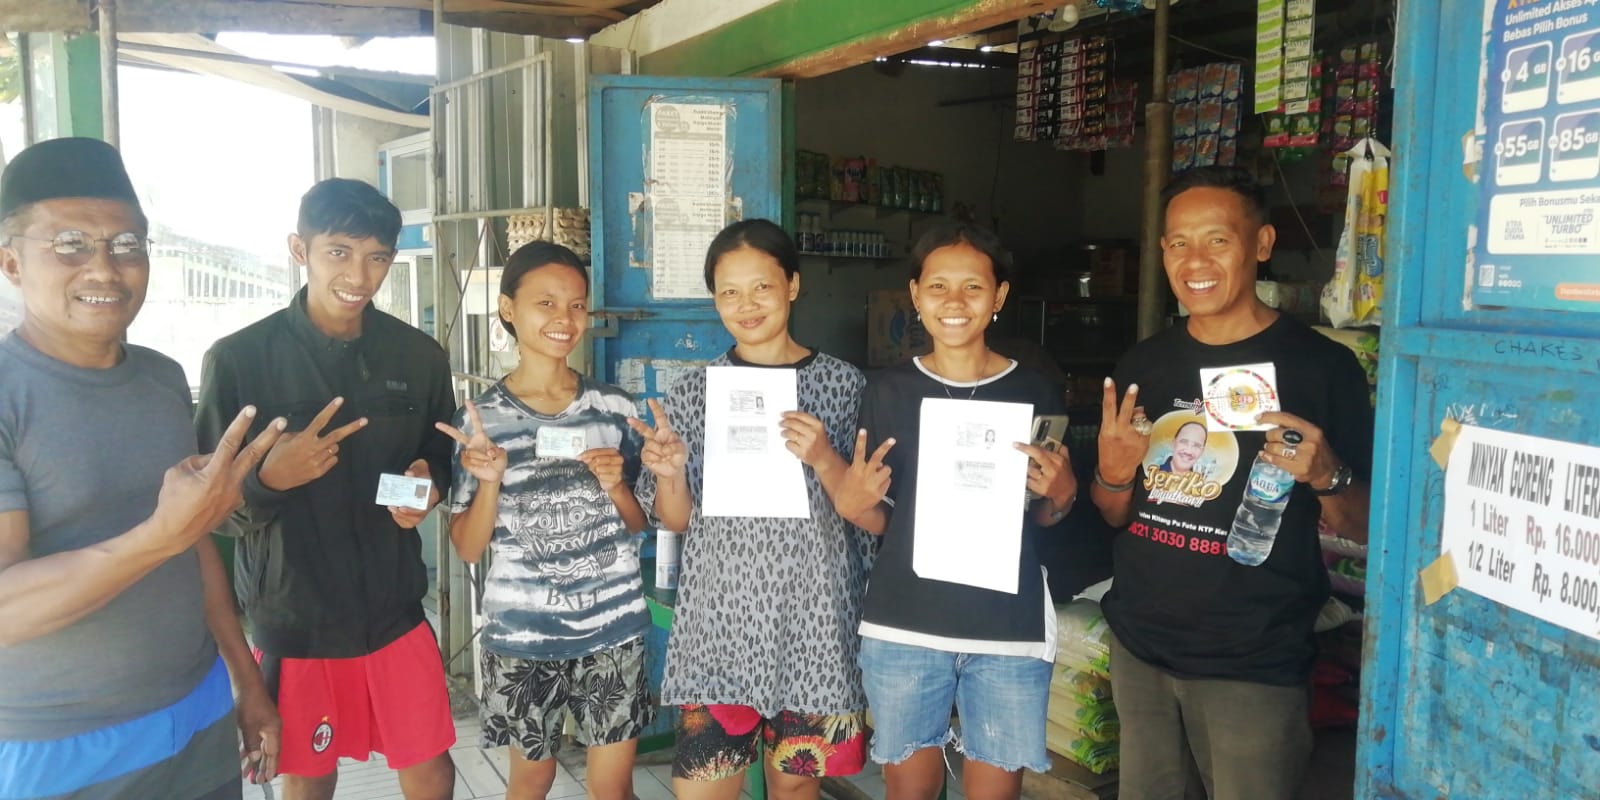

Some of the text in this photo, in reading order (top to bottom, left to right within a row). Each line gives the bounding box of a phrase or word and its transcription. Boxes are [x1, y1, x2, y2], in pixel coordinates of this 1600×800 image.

[1505, 2, 1552, 26] Unlimited
[1503, 12, 1589, 43] Bebas Pilih Bonus
[1516, 60, 1529, 83] 4
[1534, 63, 1547, 75] GB
[1568, 47, 1591, 73] 16
[1505, 134, 1528, 158] 55
[1559, 127, 1585, 152] 85
[1585, 132, 1599, 144] GB
[1545, 213, 1594, 225] UNLIMITED
[1143, 463, 1223, 501] Jeriko
[1251, 476, 1280, 494] AQUA
[1467, 441, 1600, 520] MINYAK GORENG LITER
[1151, 526, 1186, 549] 3030
[1198, 525, 1214, 534] KTP
[1470, 499, 1600, 568] 1 Liter Rp. 16.000
[1468, 540, 1484, 573] 1/2
[1488, 547, 1516, 584] Liter
[1532, 562, 1552, 603] Rp.
